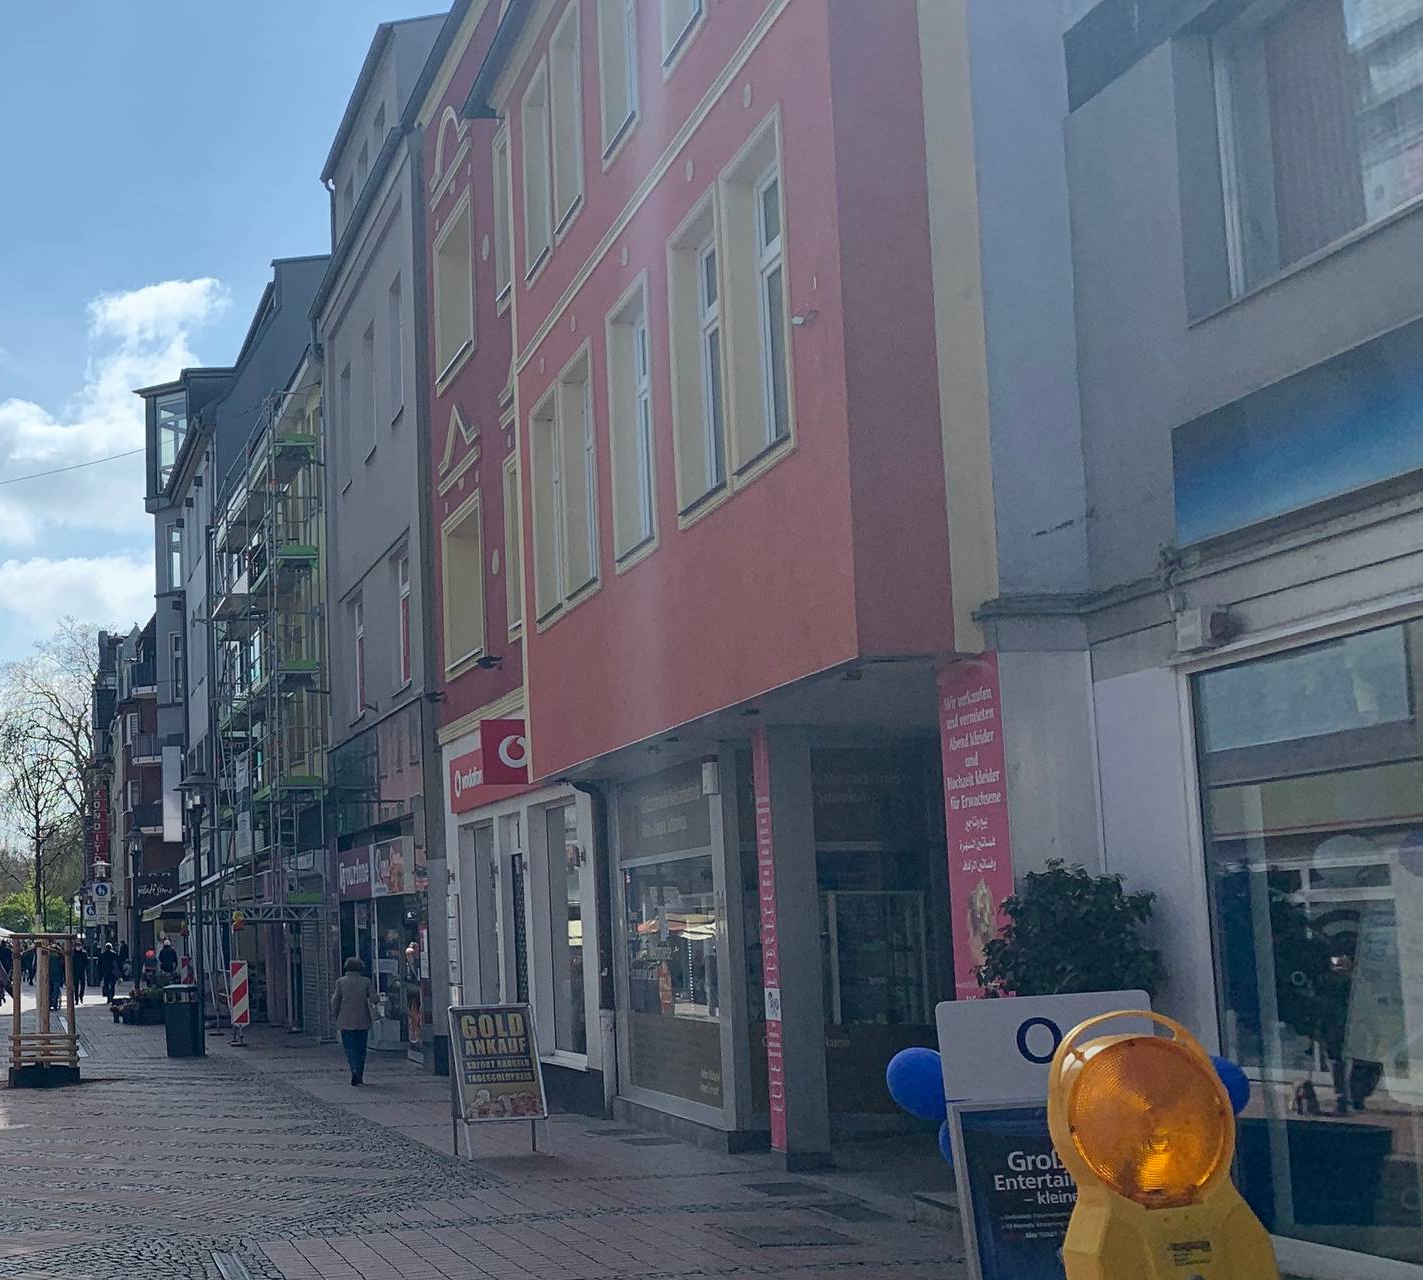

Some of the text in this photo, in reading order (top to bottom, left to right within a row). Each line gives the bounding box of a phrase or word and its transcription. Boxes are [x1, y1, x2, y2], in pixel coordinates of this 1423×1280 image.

[943, 686, 993, 710] Wir verkaufen
[945, 708, 995, 730] und vermieten
[949, 732, 969, 751] Abend
[964, 751, 979, 768] und
[461, 766, 483, 790] vodafon
[947, 774, 974, 791] Hochzeit
[950, 792, 1002, 811] für Erwachsene
[460, 1013, 525, 1039] GOLD
[464, 1037, 527, 1056] ANKAUF
[466, 1060, 495, 1070] SOFORT
